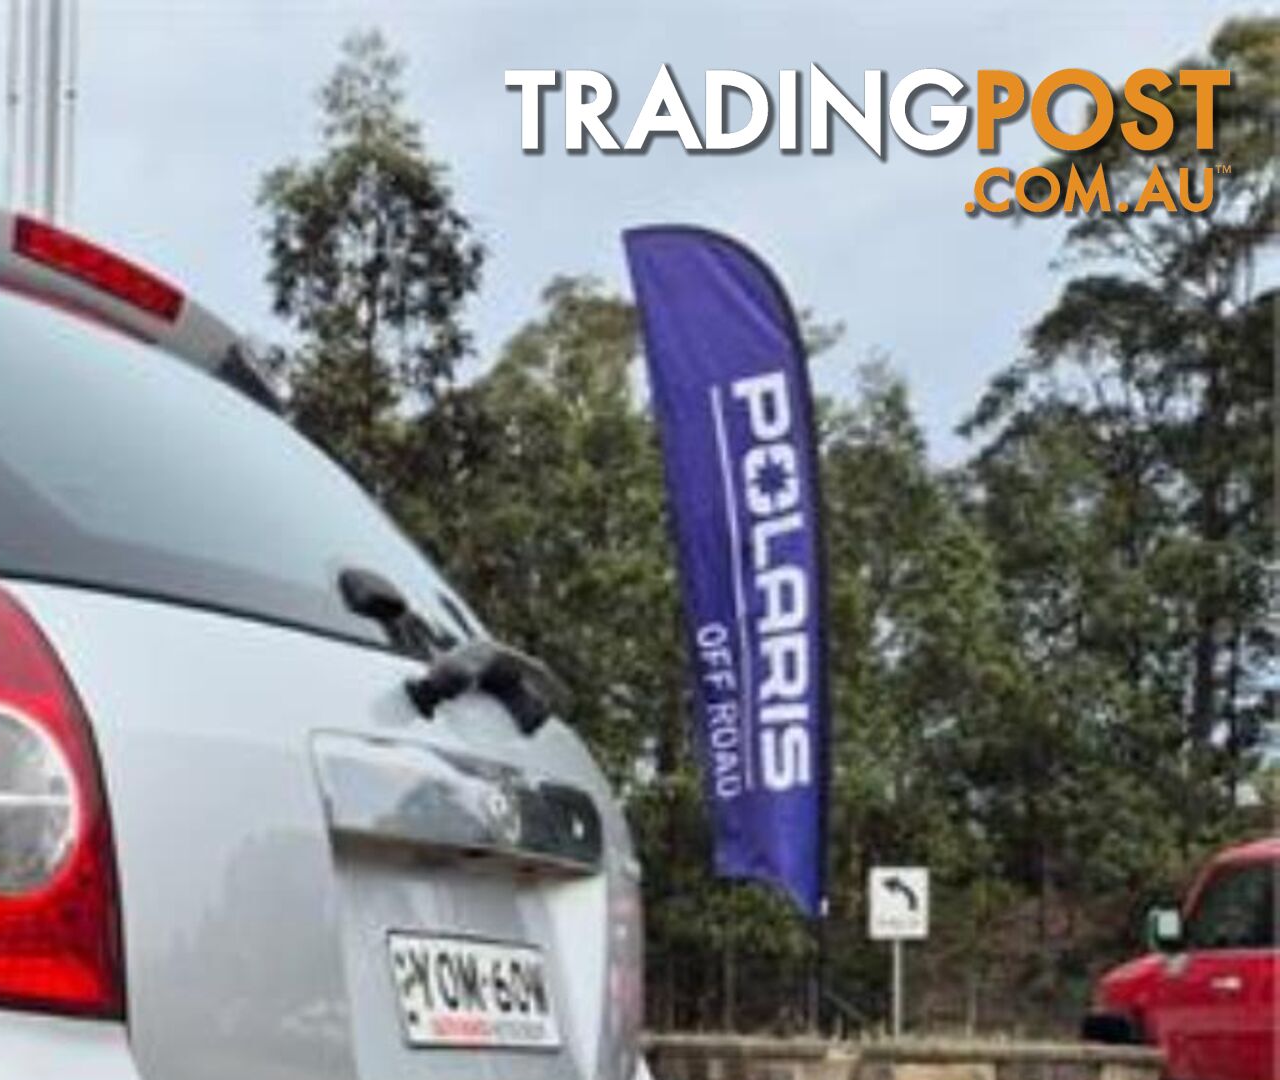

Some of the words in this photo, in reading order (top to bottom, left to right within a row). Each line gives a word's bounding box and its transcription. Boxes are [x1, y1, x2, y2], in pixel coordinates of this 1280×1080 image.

[731, 371, 810, 793] POLARIS
[696, 621, 737, 691] OFF
[706, 698, 742, 798] ROAD
